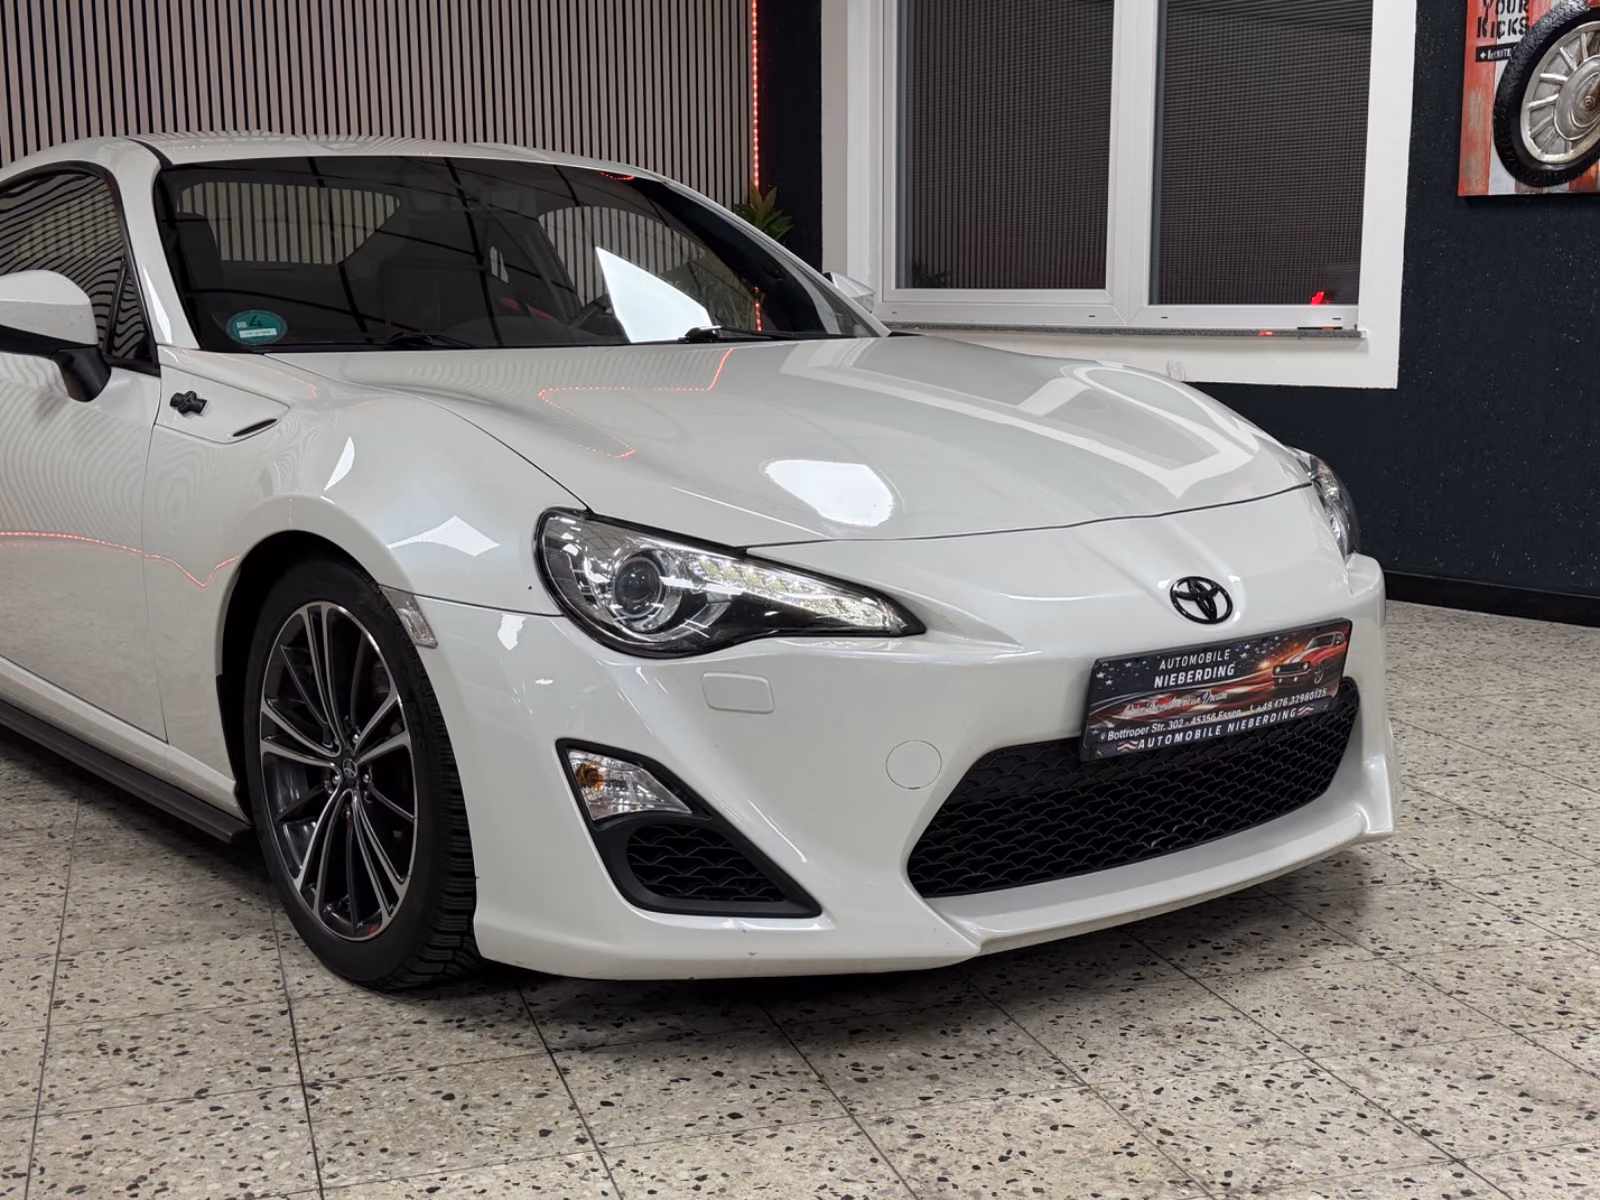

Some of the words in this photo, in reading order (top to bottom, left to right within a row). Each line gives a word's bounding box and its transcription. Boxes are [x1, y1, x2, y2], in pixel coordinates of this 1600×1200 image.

[1483, 0, 1528, 17] YOUR
[1477, 17, 1530, 39] KICKS
[249, 314, 263, 328] 4
[1159, 649, 1231, 670] AUTOMOBILE
[1154, 663, 1236, 688] NIEBERDING
[1107, 726, 1149, 741] Bottroper
[1151, 722, 1165, 733] Str.
[1168, 719, 1183, 730] 302
[1190, 713, 1216, 726] 45356
[1217, 708, 1241, 720] Essen
[1138, 725, 1222, 750] AUTOMOBILE
[1227, 708, 1297, 733] NIEBERDING
